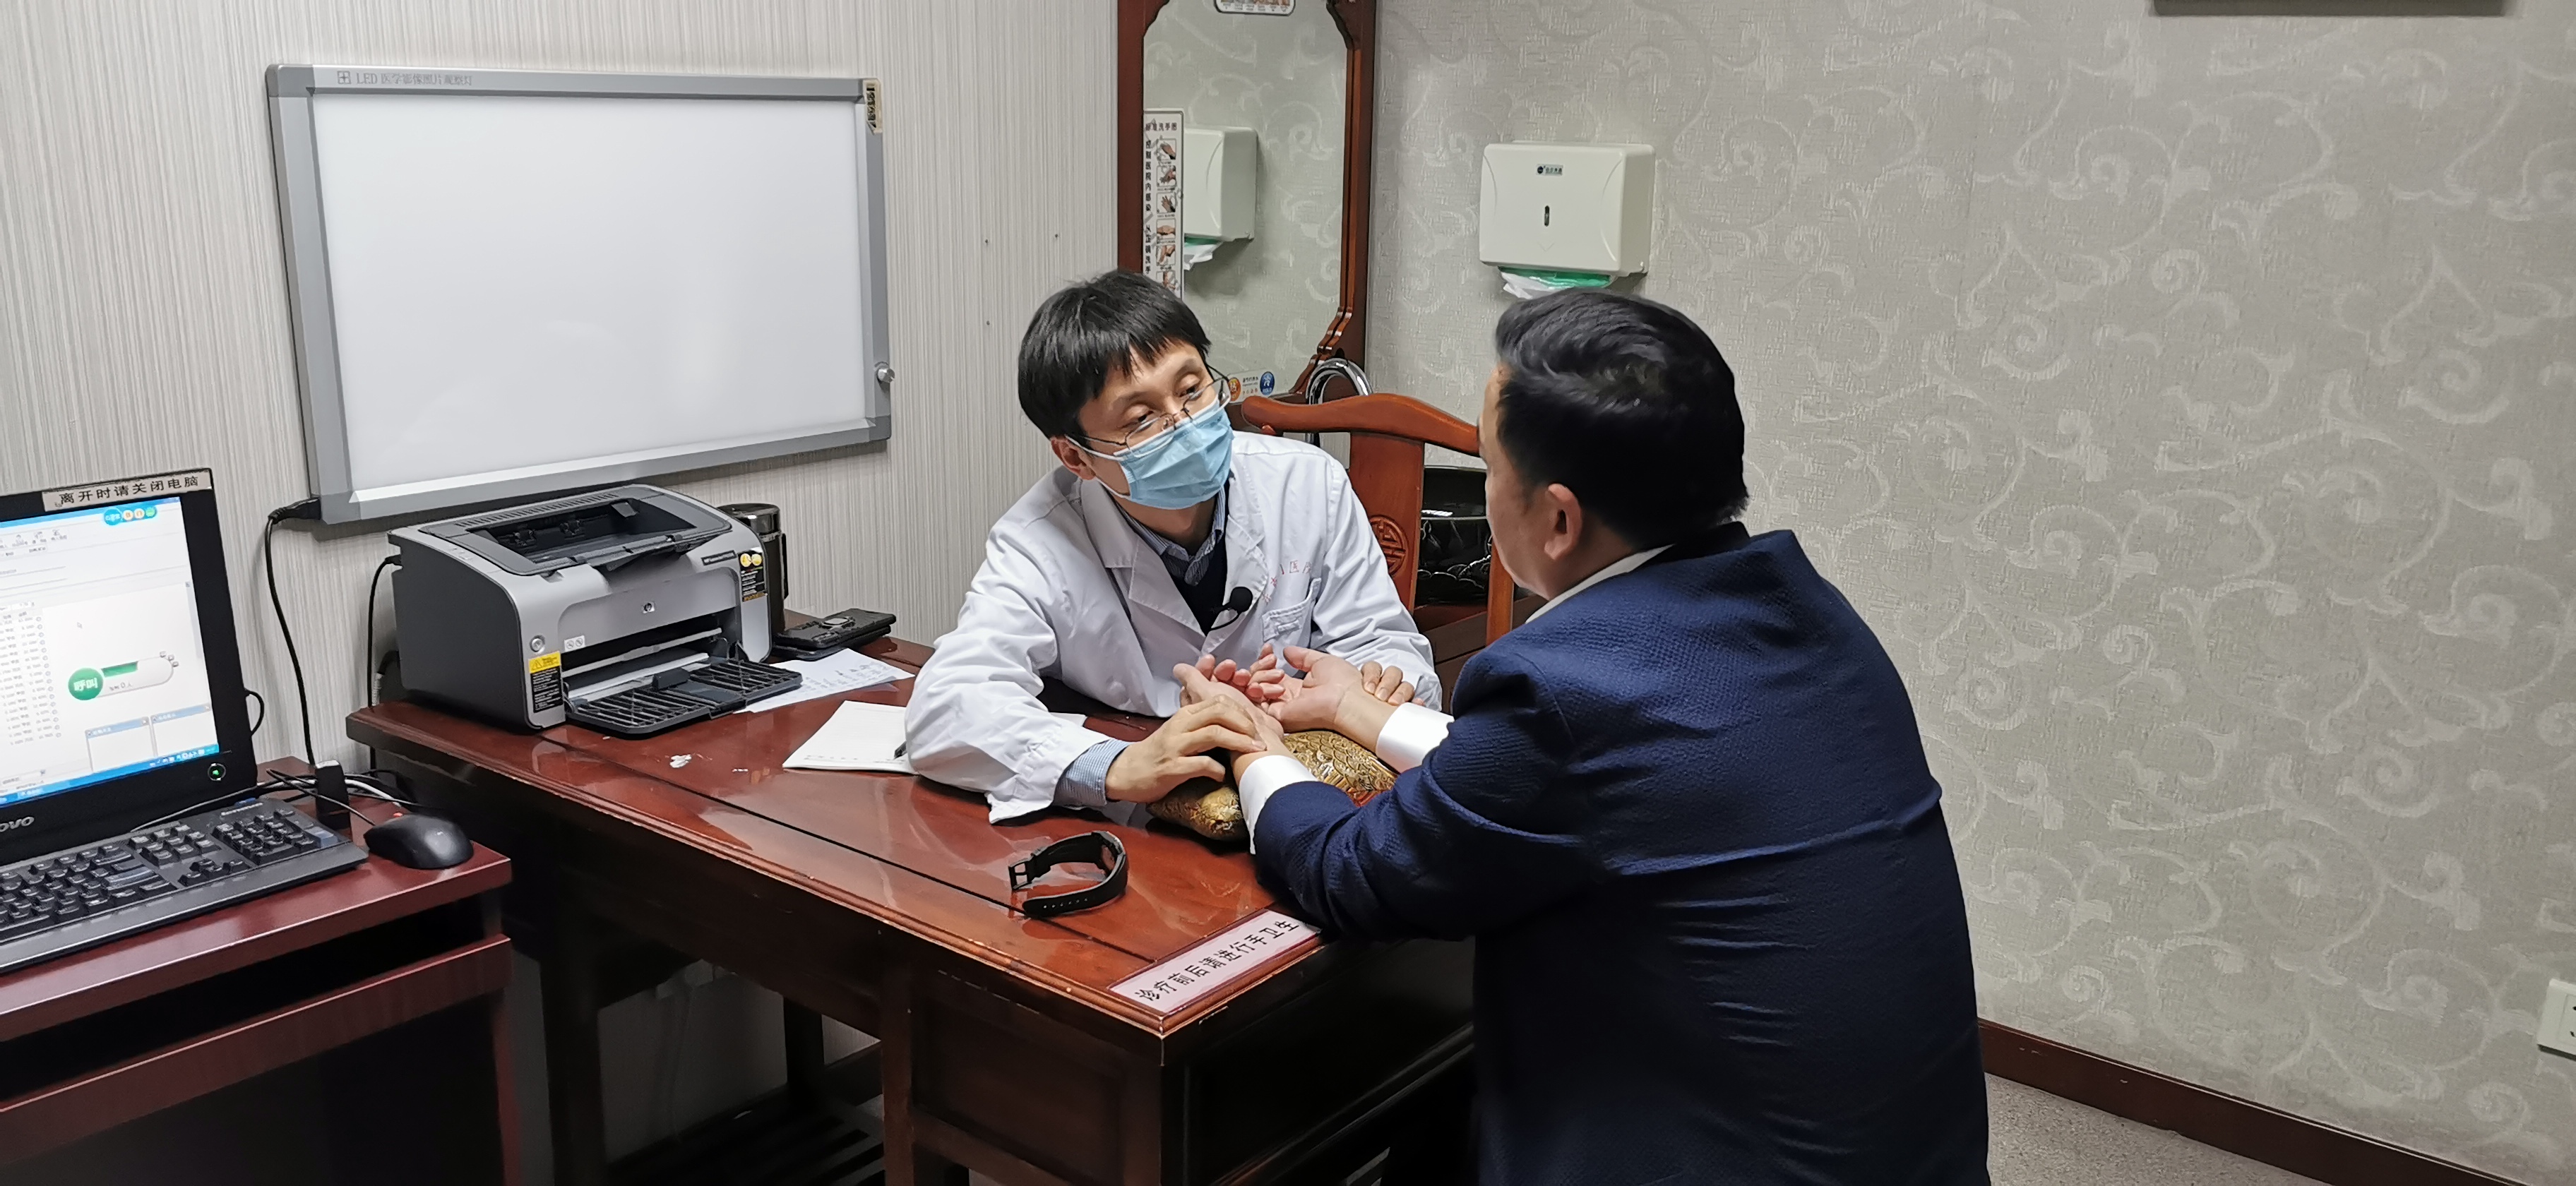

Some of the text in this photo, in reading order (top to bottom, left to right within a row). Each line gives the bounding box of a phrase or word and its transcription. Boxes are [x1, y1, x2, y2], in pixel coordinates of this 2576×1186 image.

[356, 72, 378, 84] LED
[59, 476, 198, 505] 离开时请关闭电脑
[73, 677, 97, 691] 呼叫
[1135, 920, 1299, 1001] 诊疗前后请进行手卫生
